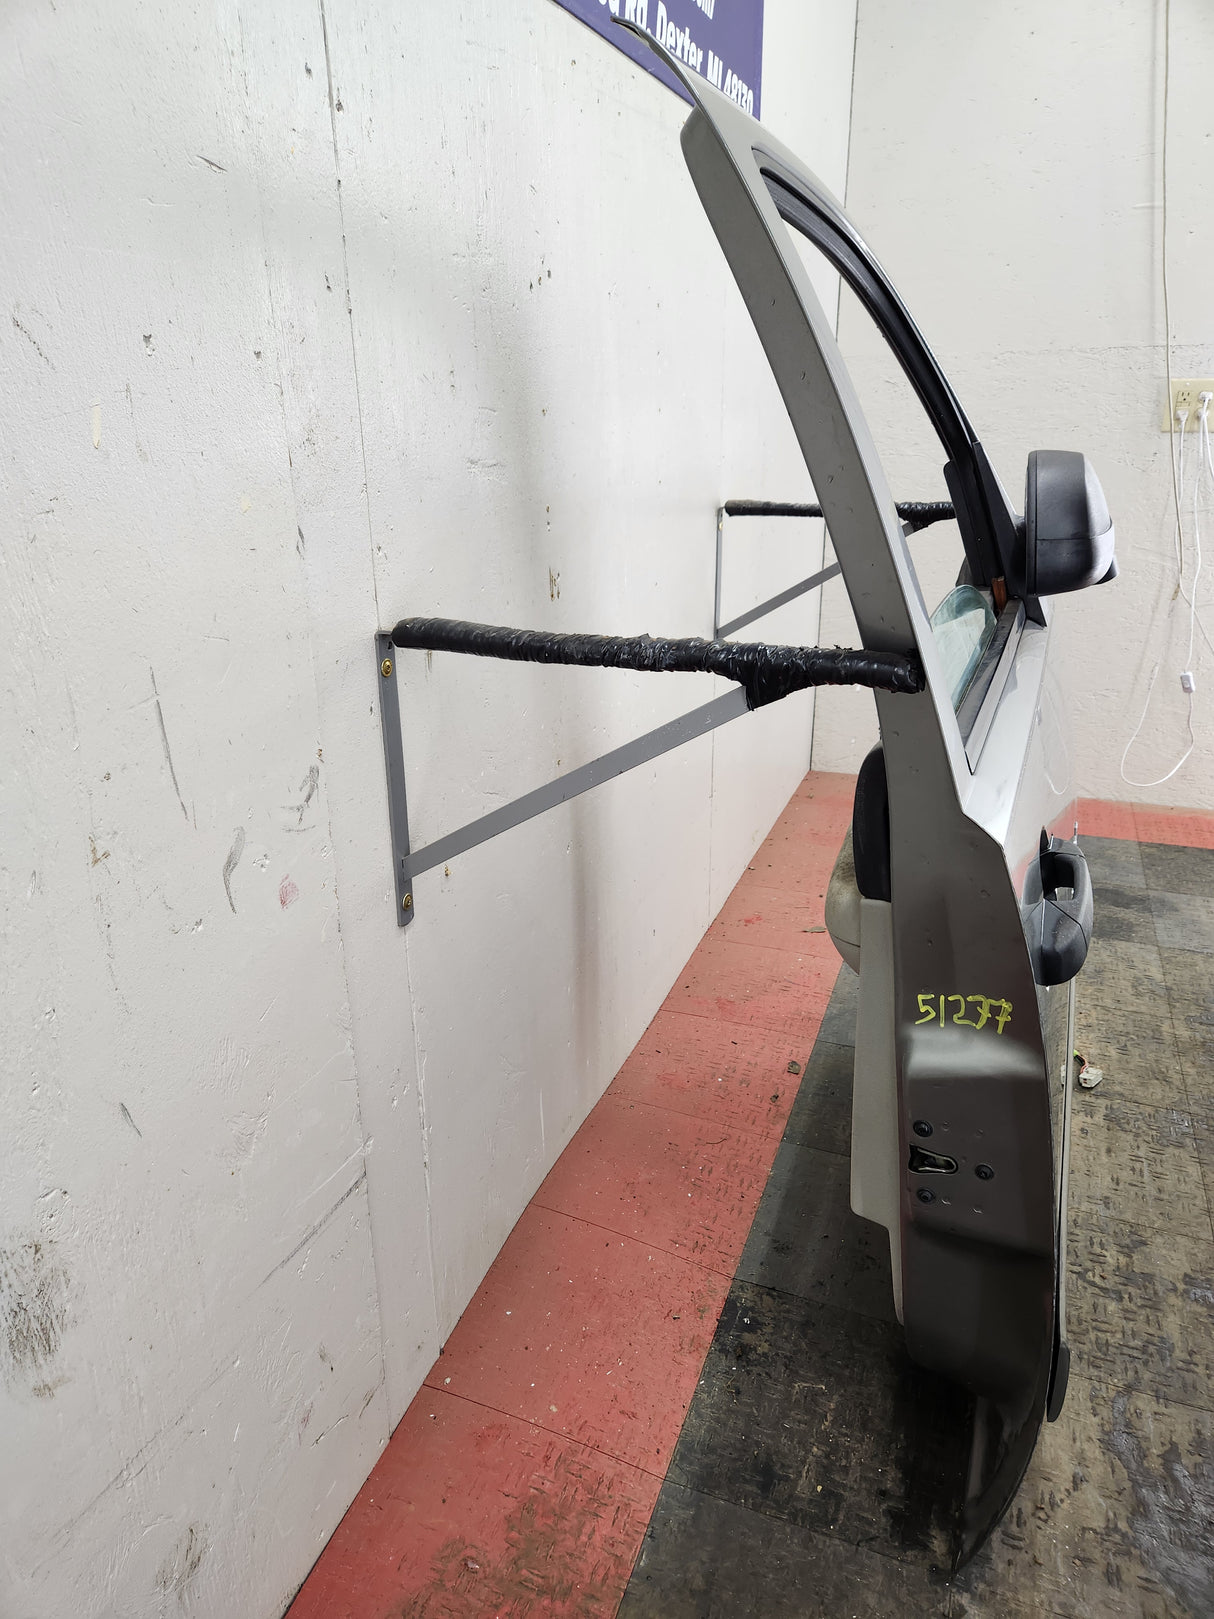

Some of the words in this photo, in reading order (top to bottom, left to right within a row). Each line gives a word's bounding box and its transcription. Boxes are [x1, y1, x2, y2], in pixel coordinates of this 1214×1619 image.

[656, 0, 704, 73] Dexter
[706, 50, 723, 90] MI
[723, 68, 754, 116] 48130
[914, 993, 1013, 1035] 51277
